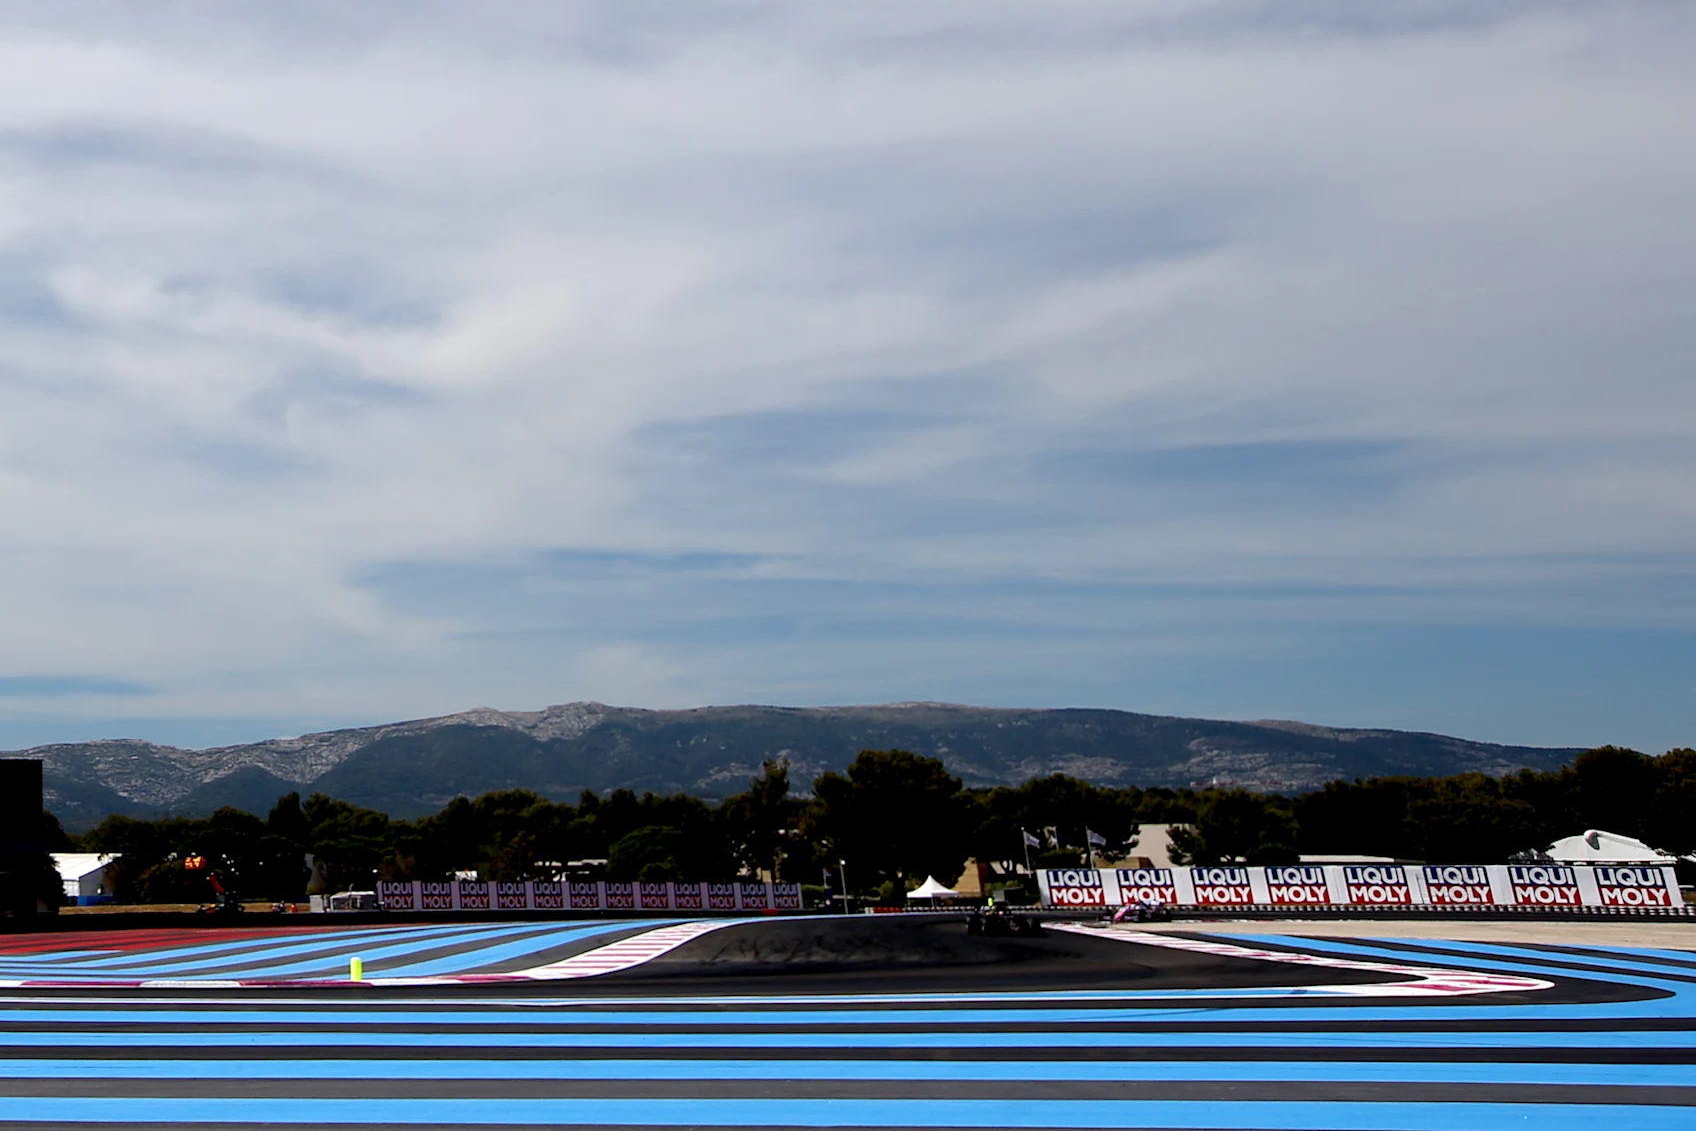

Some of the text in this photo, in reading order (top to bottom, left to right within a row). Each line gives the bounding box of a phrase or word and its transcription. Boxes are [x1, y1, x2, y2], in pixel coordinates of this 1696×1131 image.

[1048, 870, 1101, 887] LIQUI
[1118, 870, 1172, 887] LIQUI
[1193, 868, 1247, 886] LIQUI
[1267, 868, 1323, 885] LIQUI
[1346, 868, 1404, 885] LIQUI
[1426, 868, 1487, 885] LIQUI
[1512, 868, 1575, 886] LIQUI
[1596, 868, 1664, 887] LIQUI
[383, 883, 412, 895] LIQUI
[422, 883, 450, 895] LIQUI
[460, 883, 488, 895] LIQUI
[498, 883, 525, 895] LIQUI
[534, 883, 561, 895] LIQUI
[570, 883, 596, 895] LIQUI
[606, 883, 632, 895] LIQUI
[641, 883, 666, 895] LIQUI
[675, 883, 700, 895] LIQUI
[709, 883, 734, 895] LIQUI
[742, 883, 765, 895] LIQUI
[774, 883, 797, 895] LIQUI
[1196, 887, 1251, 902] MOLY
[1271, 886, 1326, 902] MOLY
[1350, 886, 1408, 902] MOLY
[1430, 886, 1490, 902] MOLY
[1516, 886, 1578, 904] MOLY
[1053, 888, 1103, 904] MOLY
[1121, 888, 1175, 903] MOLY
[1602, 888, 1666, 905] MOLY
[384, 896, 413, 908] MOLY
[424, 896, 452, 908] MOLY
[462, 896, 489, 908] MOLY
[499, 896, 526, 908] MOLY
[535, 896, 563, 908] MOLY
[572, 896, 598, 908] MOLY
[607, 896, 634, 908] MOLY
[642, 896, 668, 908] MOLY
[676, 896, 701, 908] MOLY
[710, 896, 735, 908] MOLY
[743, 896, 766, 908] MOLY
[775, 896, 798, 908] MOLY
